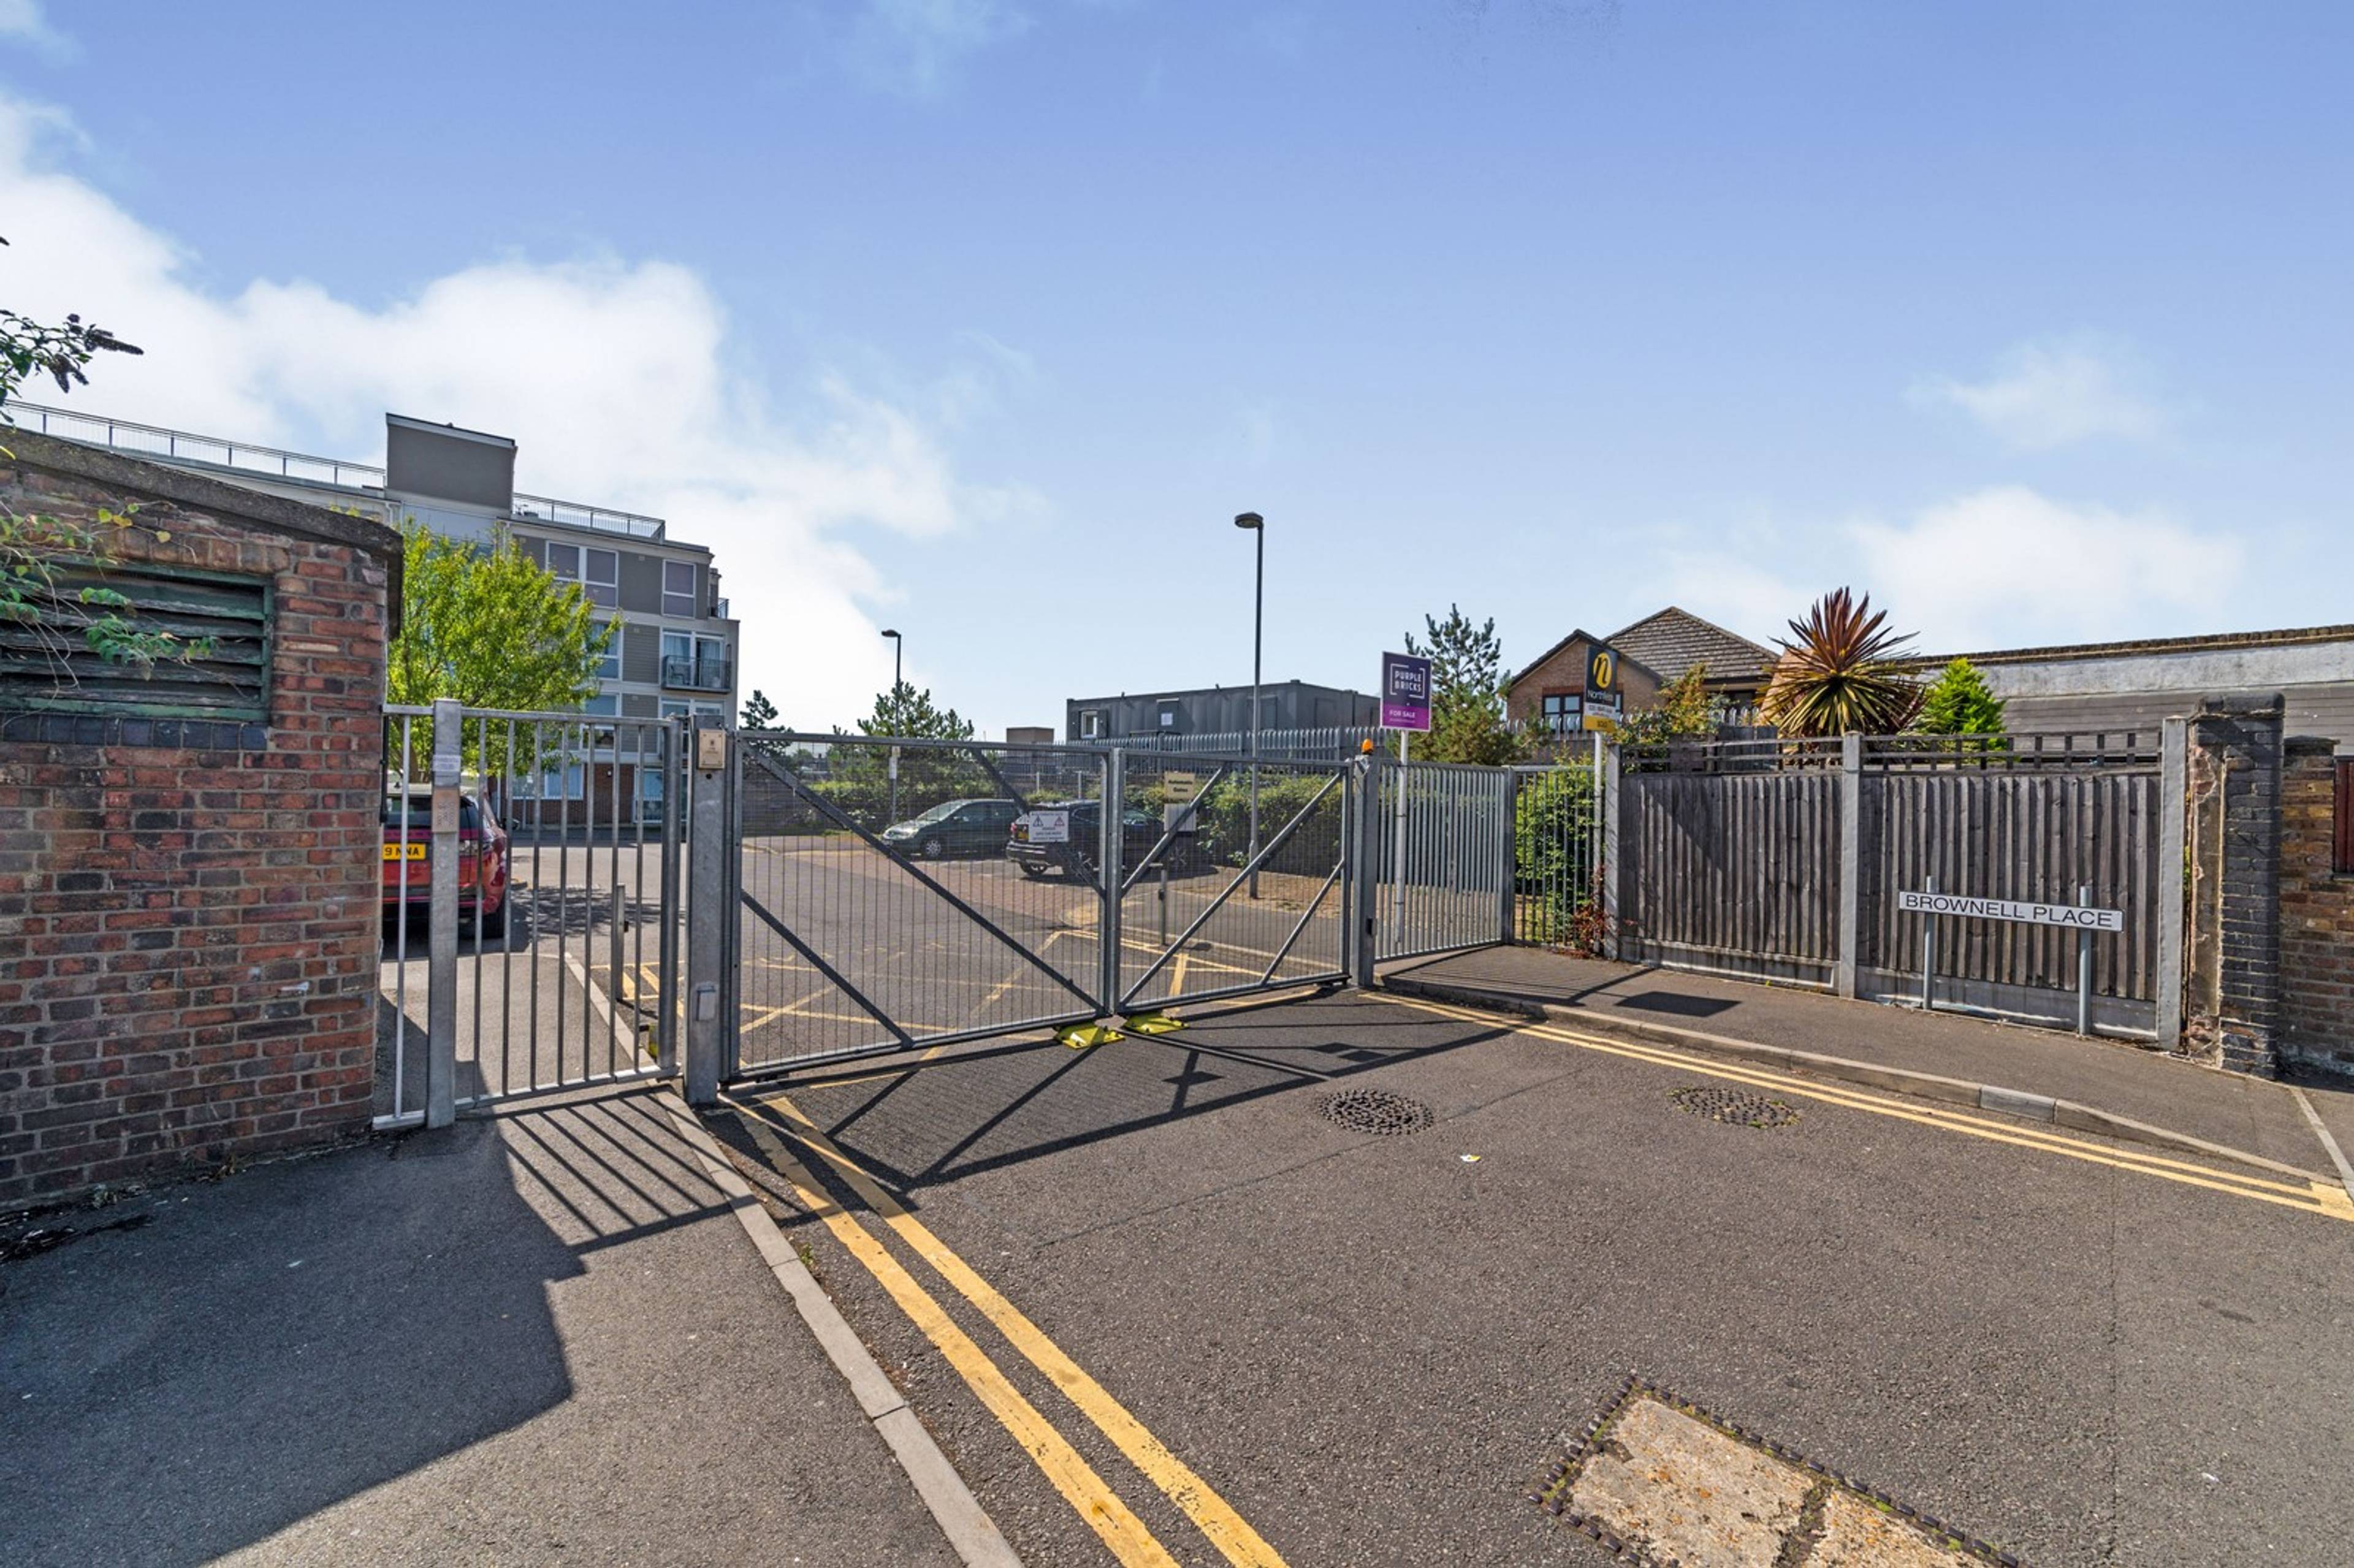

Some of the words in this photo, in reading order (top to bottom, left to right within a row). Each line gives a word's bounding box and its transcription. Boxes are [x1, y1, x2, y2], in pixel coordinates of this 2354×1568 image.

[1395, 671, 1421, 682] PURPLE
[1395, 681, 1421, 692] BRICKS
[1906, 894, 2025, 919] BROWNELL
[2033, 906, 2112, 927] PLACE
